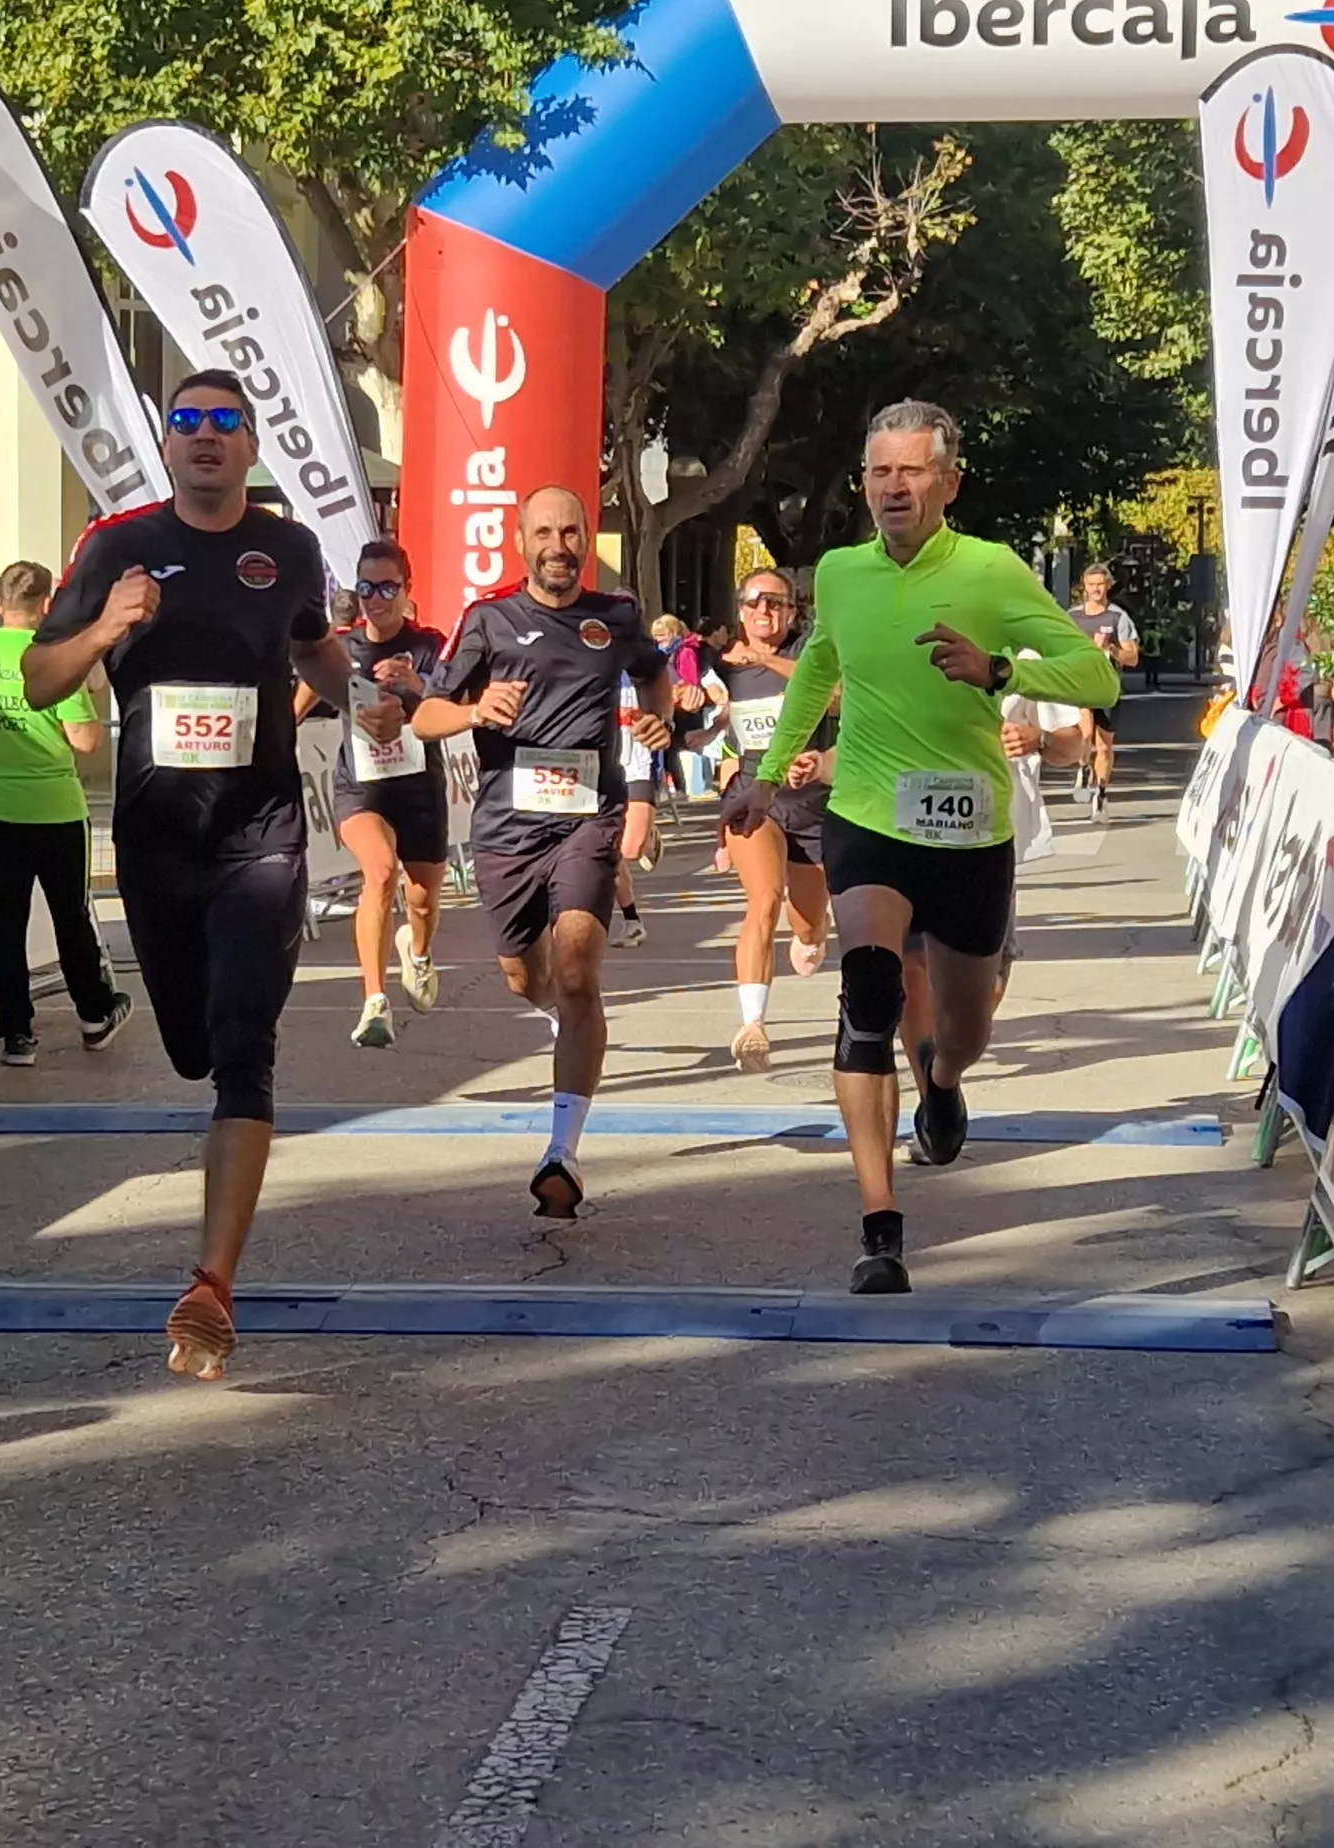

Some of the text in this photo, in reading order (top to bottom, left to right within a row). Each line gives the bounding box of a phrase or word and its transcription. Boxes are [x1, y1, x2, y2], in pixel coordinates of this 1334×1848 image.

[891, 0, 1257, 60] Ibercaja
[174, 714, 233, 738] 552
[742, 715, 776, 733] 260
[174, 741, 232, 752] ARTURO
[532, 764, 580, 786] 553
[919, 794, 974, 818] 140
[915, 817, 975, 830] MARIANO
